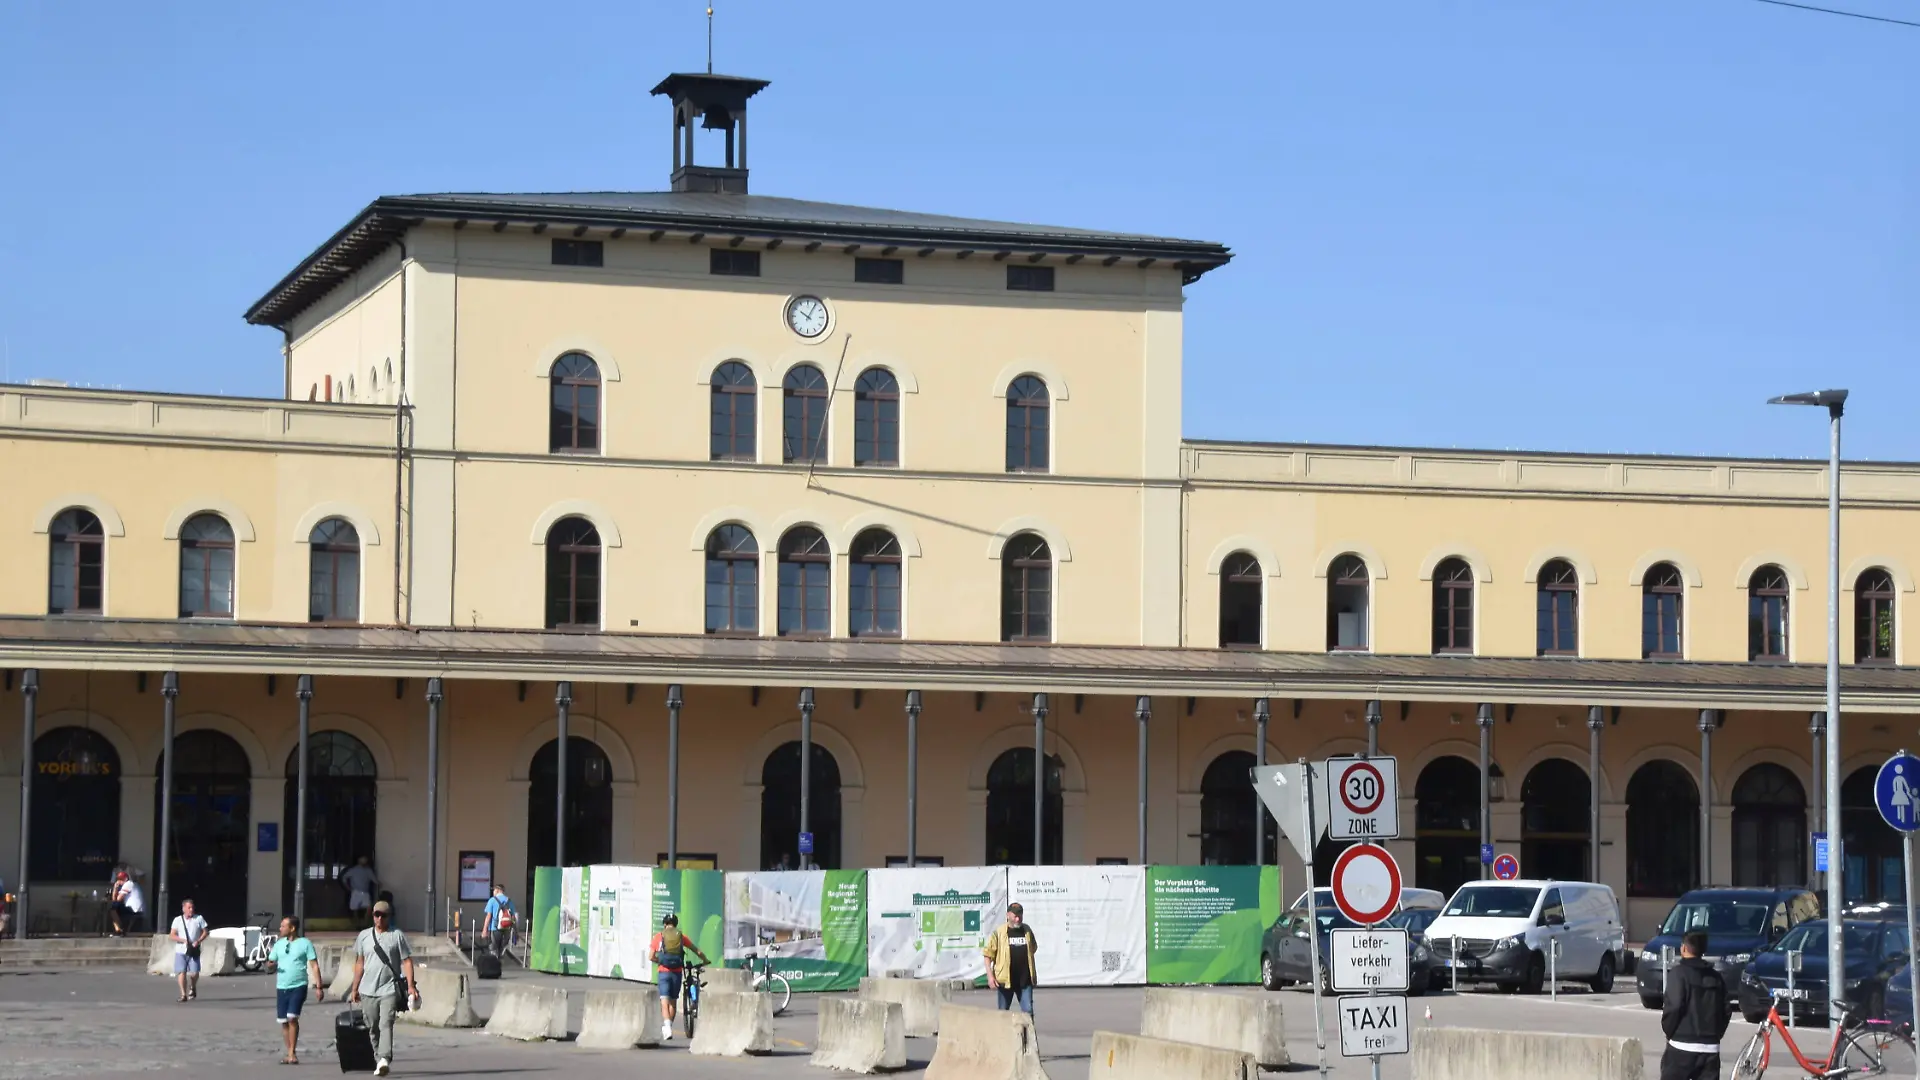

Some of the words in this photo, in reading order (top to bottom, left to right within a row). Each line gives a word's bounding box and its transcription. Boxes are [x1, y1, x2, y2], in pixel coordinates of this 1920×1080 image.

[1349, 777, 1375, 800] 30
[1348, 818, 1377, 834] ZONE
[1352, 935, 1389, 949] Liefer-
[1350, 953, 1392, 967] verkehr
[1362, 972, 1381, 986] frei
[1346, 1005, 1397, 1031] TAXI
[1364, 1034, 1385, 1049] frei
